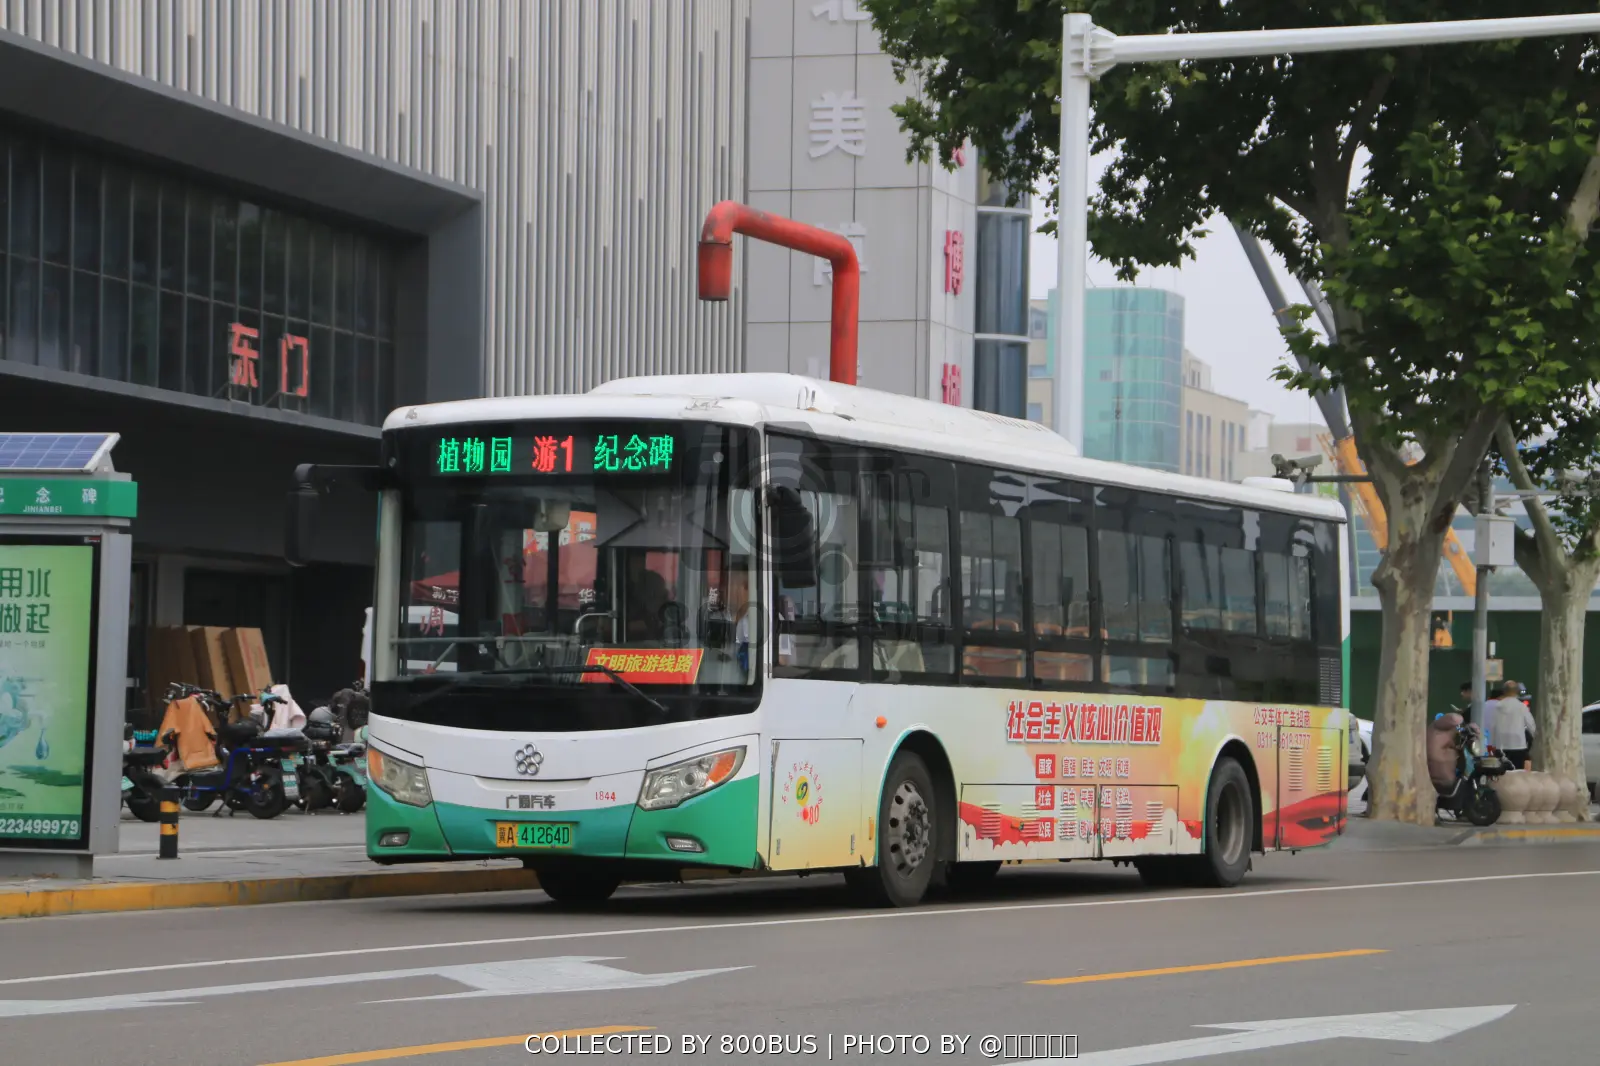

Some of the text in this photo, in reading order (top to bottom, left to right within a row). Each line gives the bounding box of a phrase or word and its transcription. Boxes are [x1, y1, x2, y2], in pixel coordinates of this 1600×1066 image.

[231, 322, 308, 397] 东门
[437, 434, 674, 473] 植物园 游1 纪念碑
[595, 653, 694, 673] 文明旅游线路
[1007, 700, 1163, 745] 社会主义核心价值观
[1037, 757, 1053, 776] 国家
[595, 791, 616, 801] 1844
